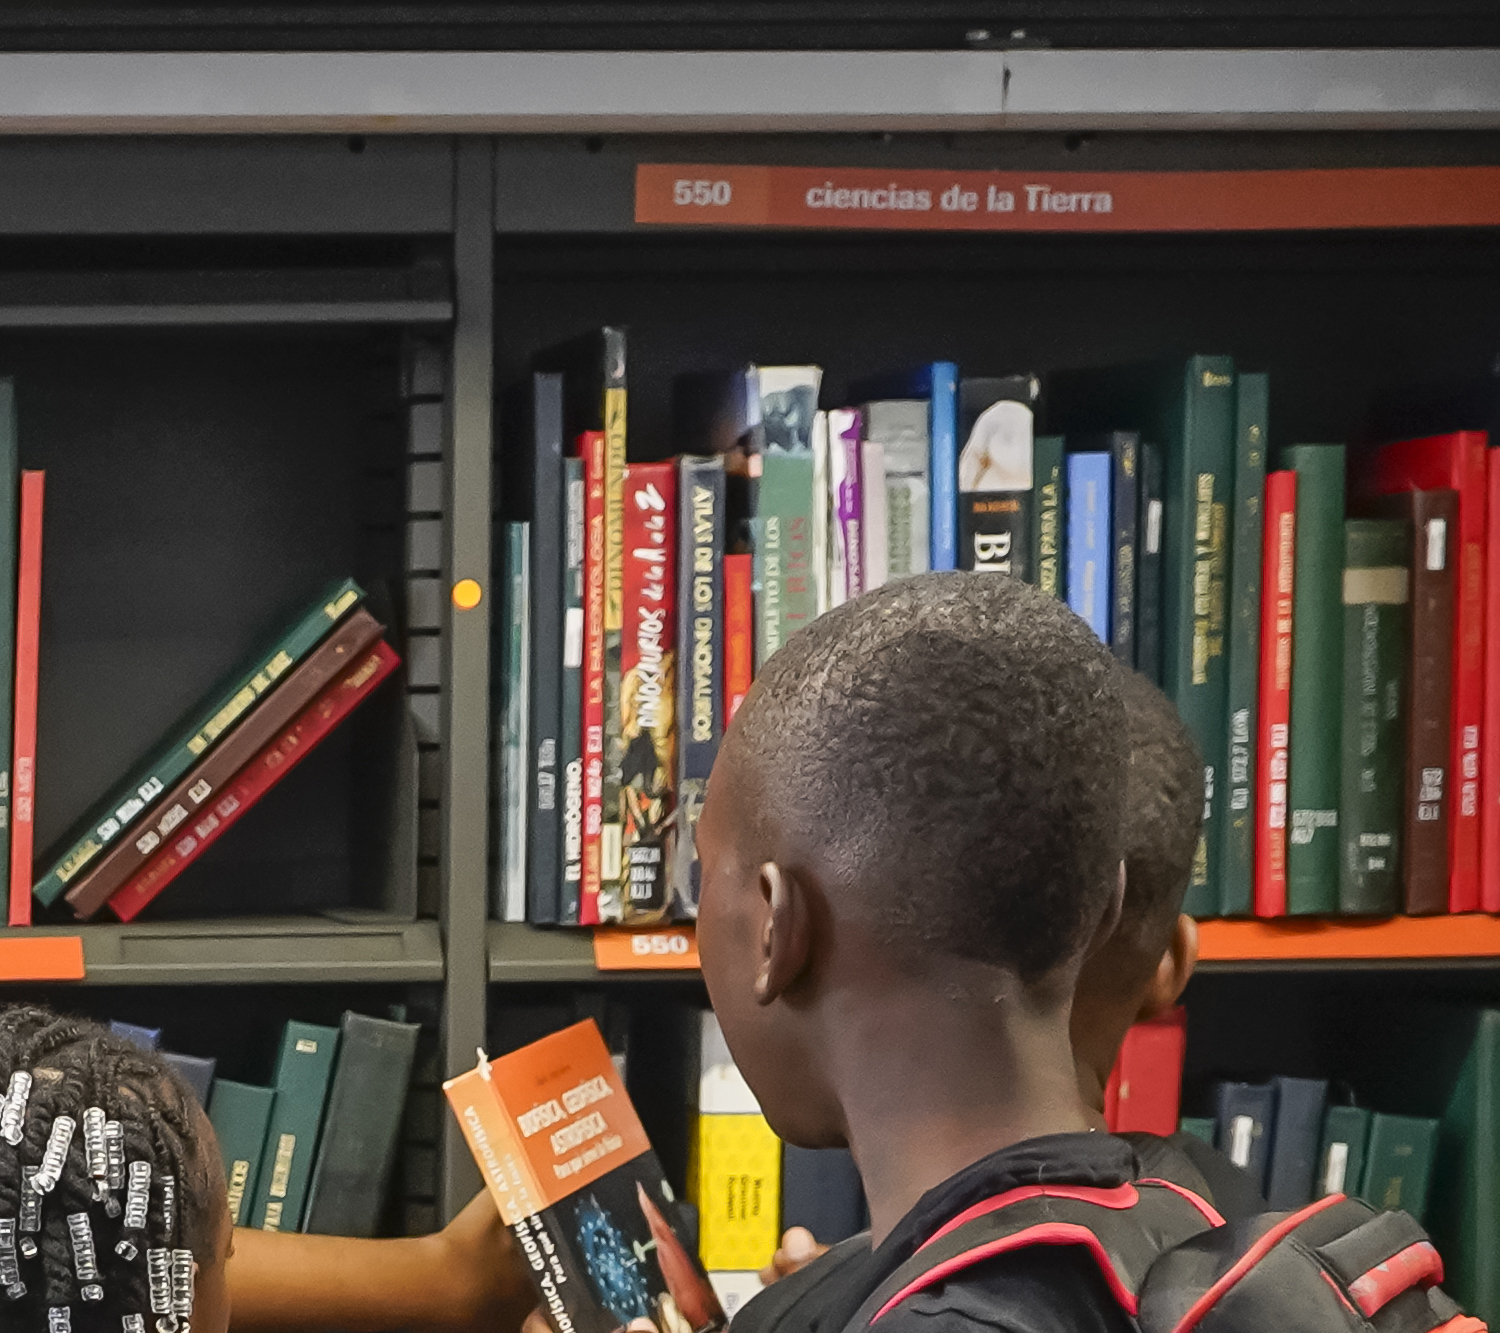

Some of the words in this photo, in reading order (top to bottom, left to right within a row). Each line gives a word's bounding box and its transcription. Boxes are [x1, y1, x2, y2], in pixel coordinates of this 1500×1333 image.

[673, 179, 732, 206] 550
[806, 180, 932, 210] ciencias
[941, 182, 977, 212] de
[1025, 184, 1113, 213] Tierra
[1039, 485, 1056, 506] LA
[693, 486, 714, 543] ATLAS
[1039, 510, 1058, 555] PARA
[632, 549, 666, 561] A
[693, 547, 711, 571] DE
[640, 583, 663, 601] de
[693, 577, 711, 611] LOS
[637, 607, 665, 728] DINOSAURIOS
[692, 618, 711, 741] DINOSAURIOS
[589, 676, 604, 703] LA
[631, 934, 690, 955] 550
[551, 1256, 567, 1284] Para
